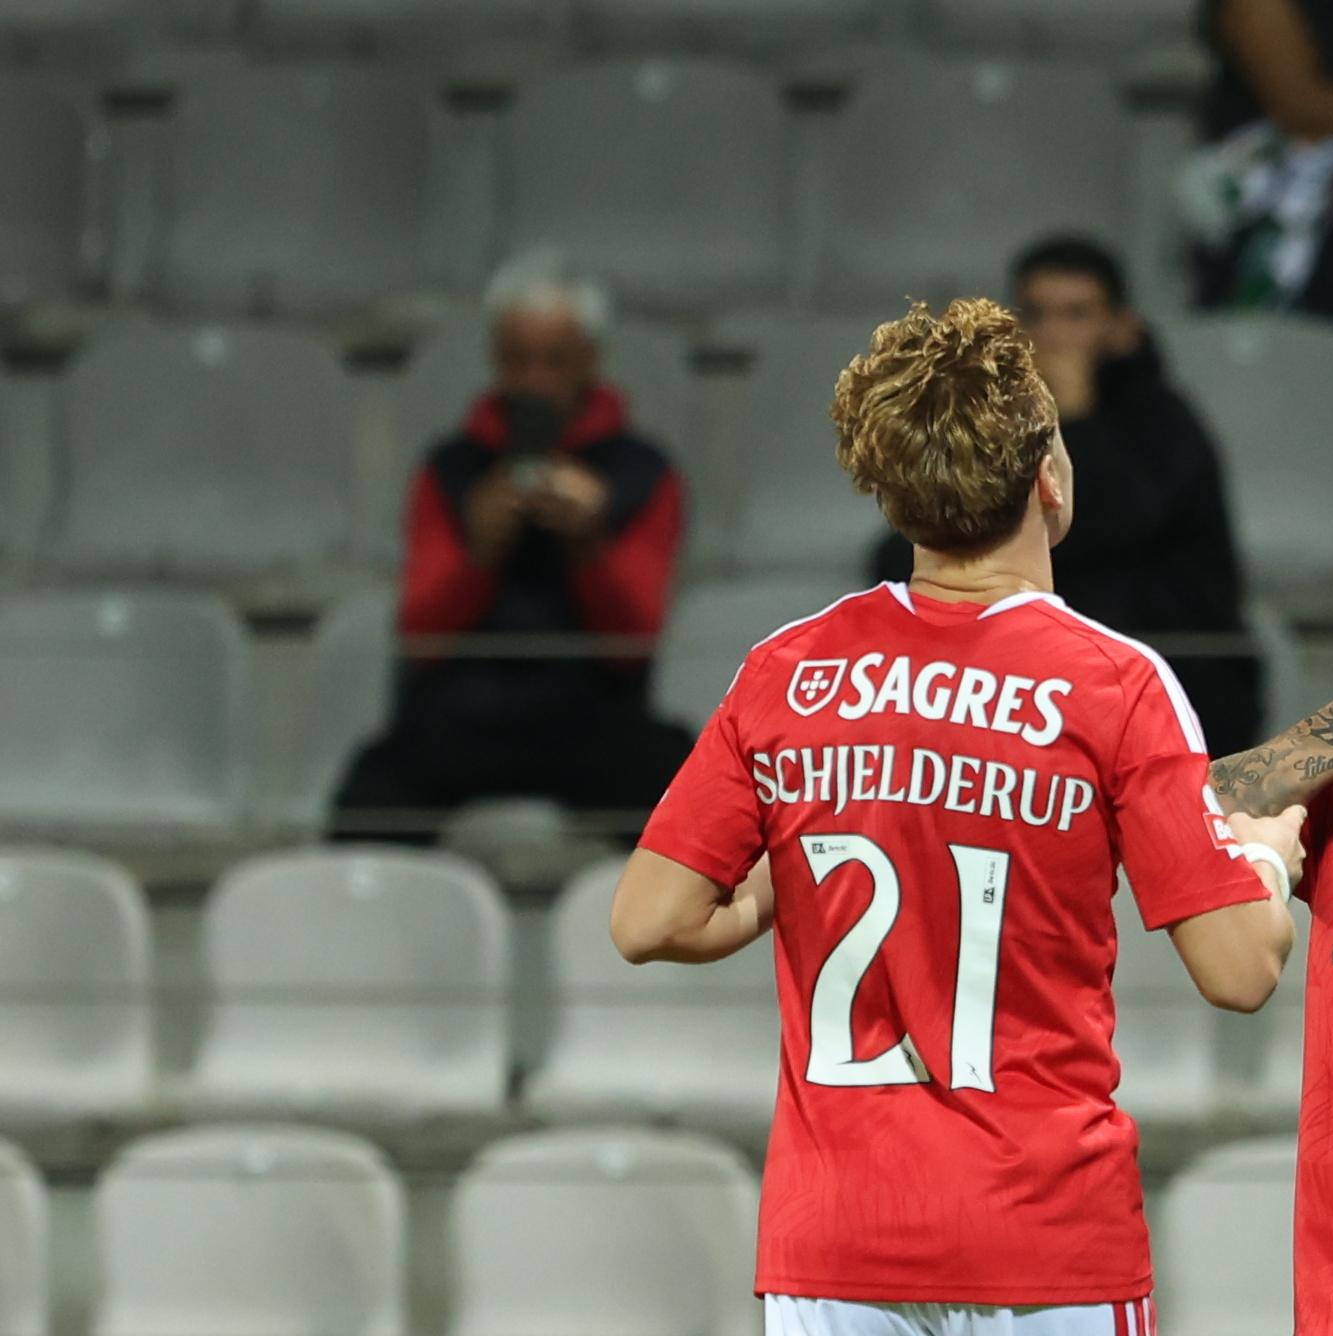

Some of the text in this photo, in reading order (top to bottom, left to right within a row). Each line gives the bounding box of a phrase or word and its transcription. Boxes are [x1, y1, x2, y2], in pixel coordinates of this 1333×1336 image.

[837, 652, 1073, 747] SAGRES
[752, 745, 1095, 832] SCHJELDERUP
[799, 834, 1012, 1094] 21
